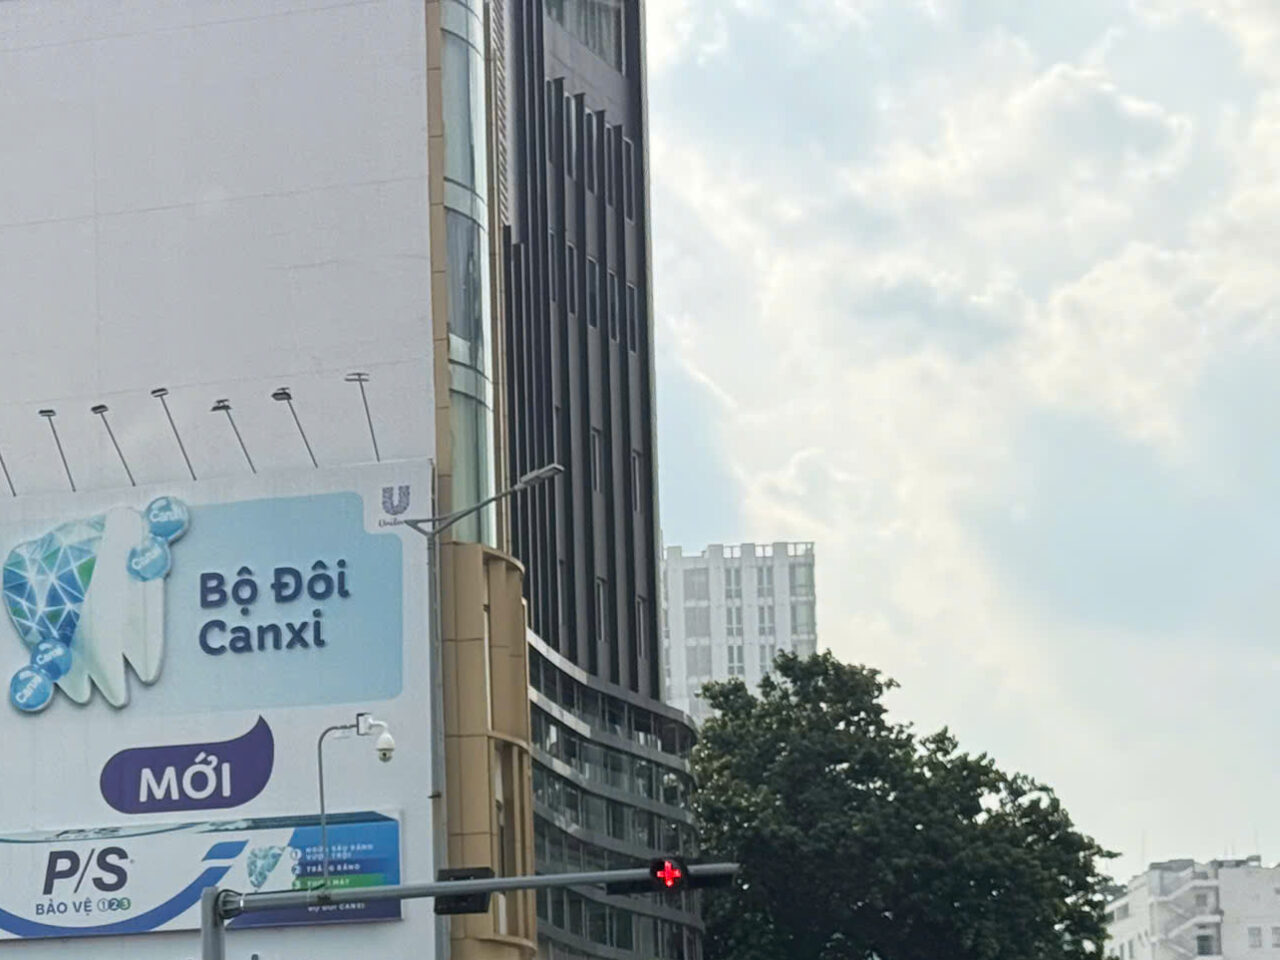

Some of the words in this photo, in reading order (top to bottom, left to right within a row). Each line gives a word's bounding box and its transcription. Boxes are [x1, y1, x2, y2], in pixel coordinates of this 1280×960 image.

[200, 566, 258, 616] Bộ
[270, 559, 351, 603] Đôi
[199, 608, 326, 656] Canxi
[139, 751, 231, 802] MỚI
[42, 846, 129, 895] P/S
[36, 899, 68, 916] BẢO
[73, 899, 93, 917] VỆ
